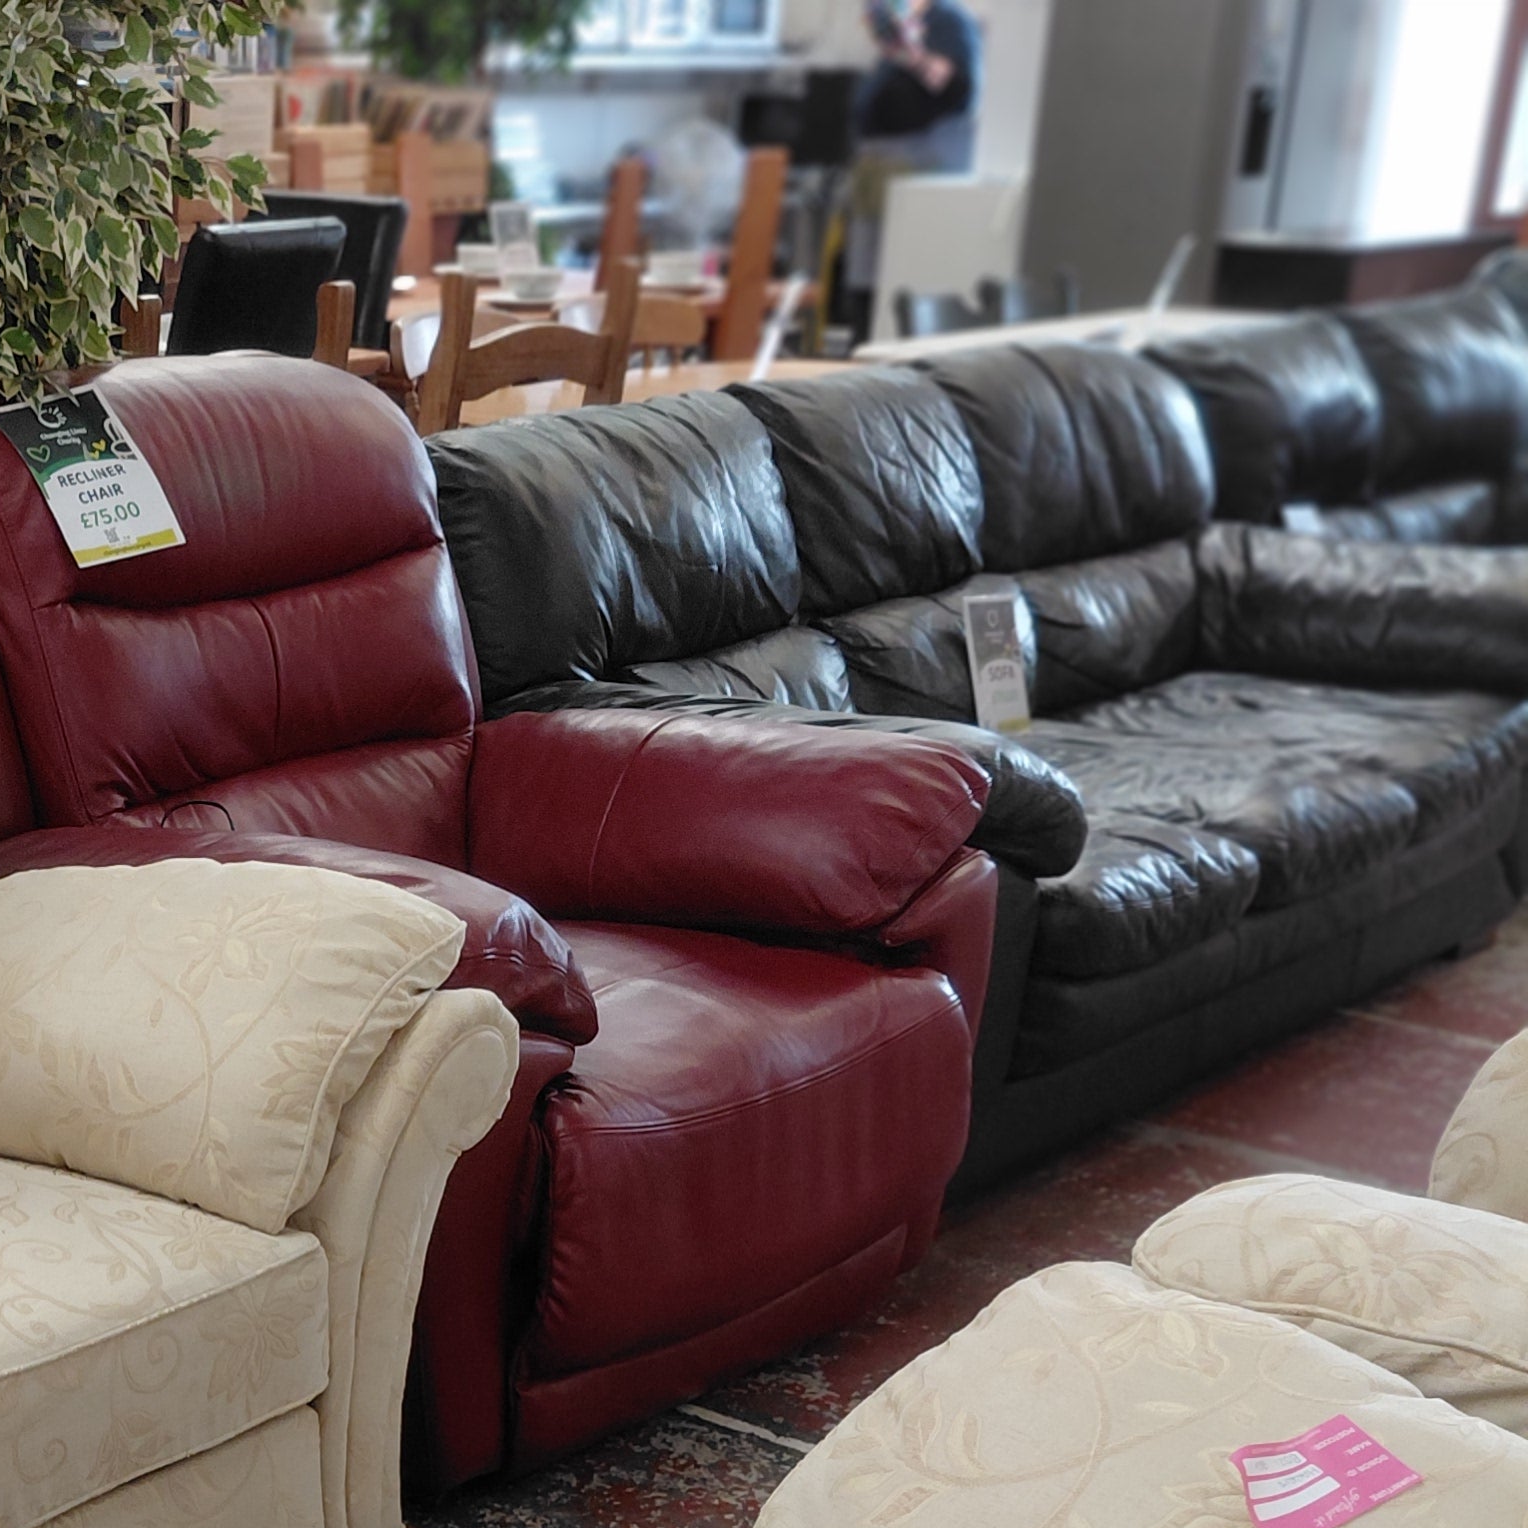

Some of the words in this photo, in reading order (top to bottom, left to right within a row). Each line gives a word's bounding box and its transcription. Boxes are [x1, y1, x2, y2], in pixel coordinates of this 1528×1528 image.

[57, 463, 127, 488] RECLINER
[78, 482, 124, 505] CHAIR
[80, 501, 141, 529] £75.00
